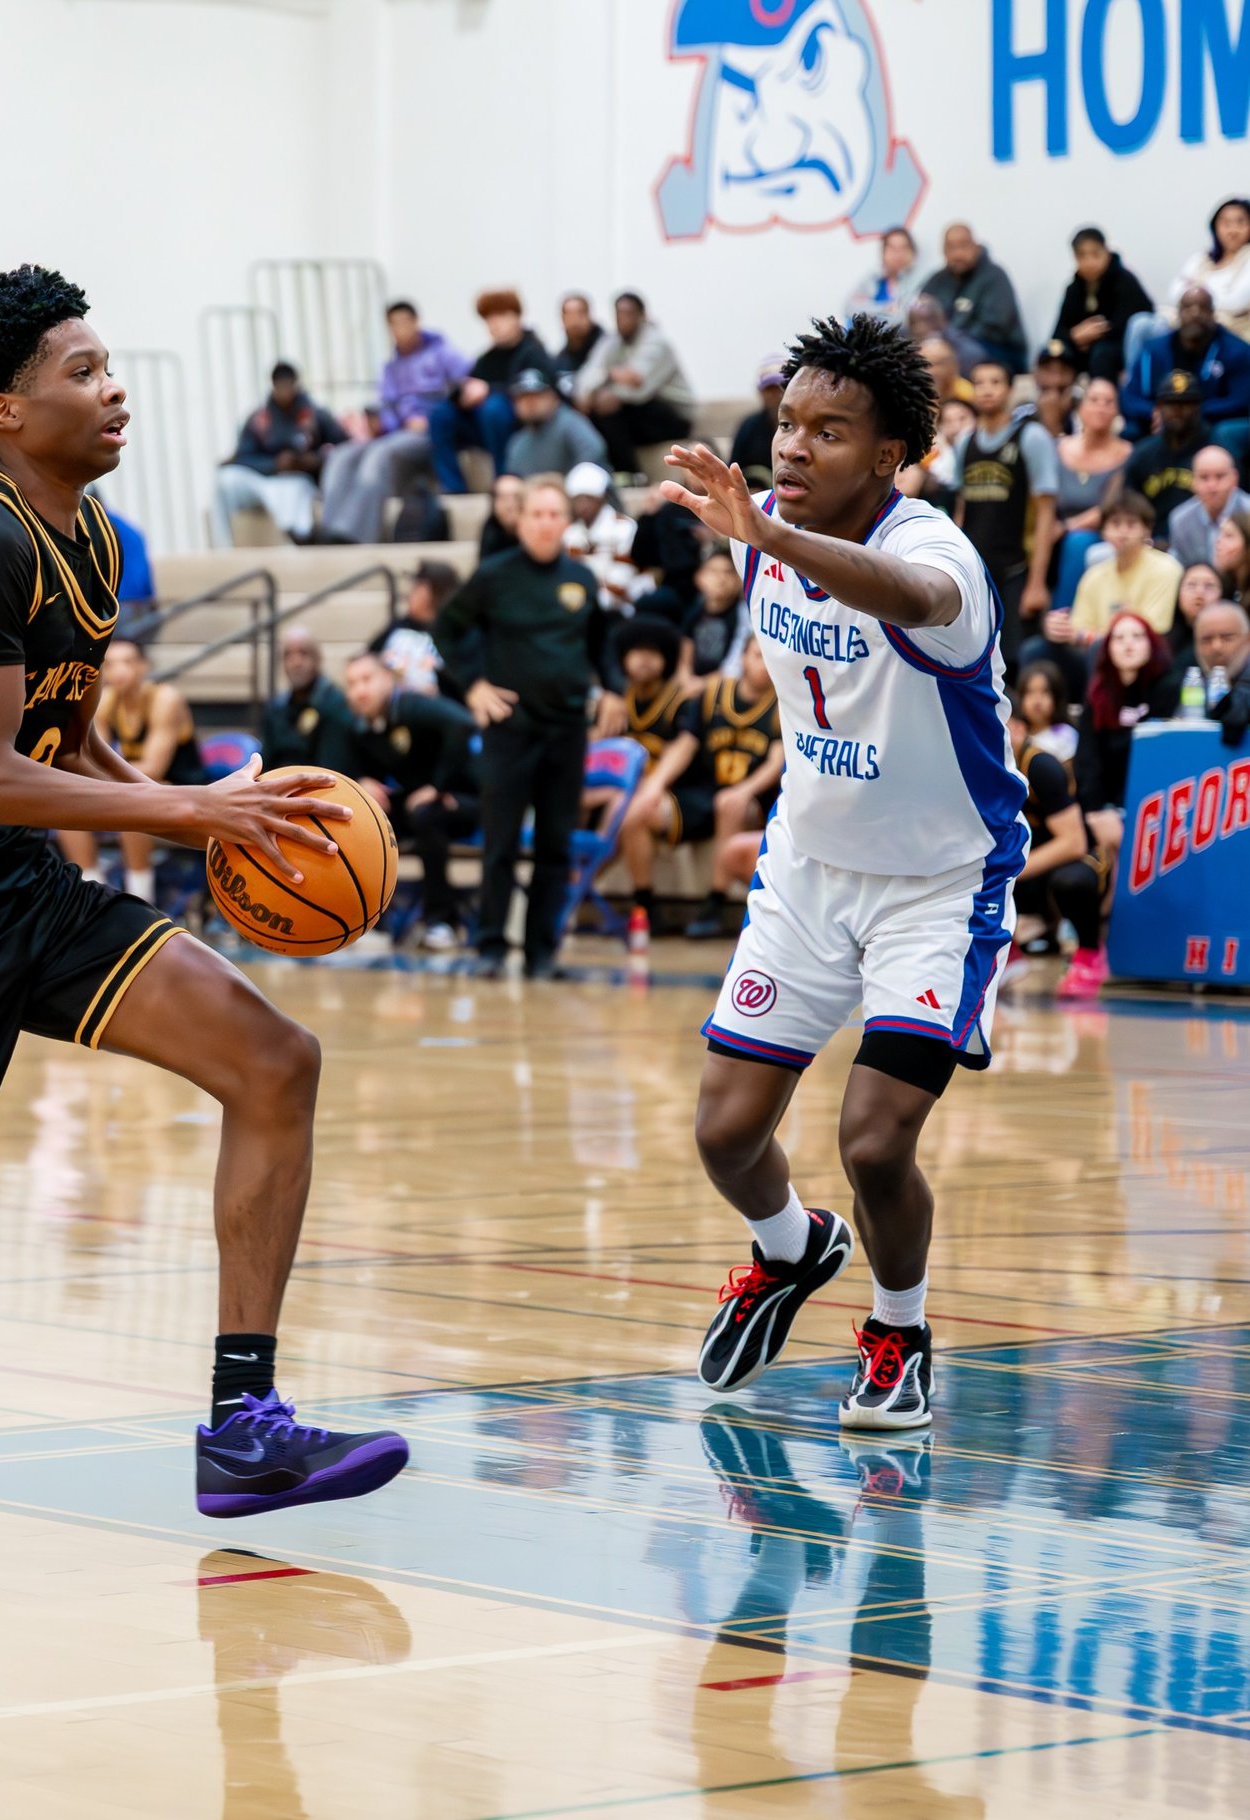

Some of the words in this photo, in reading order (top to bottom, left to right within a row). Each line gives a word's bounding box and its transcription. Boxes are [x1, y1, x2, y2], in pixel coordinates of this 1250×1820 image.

[991, 0, 1250, 163] HOM
[760, 597, 791, 645] LOS
[803, 665, 833, 730] 1
[209, 839, 296, 936] Wilson
